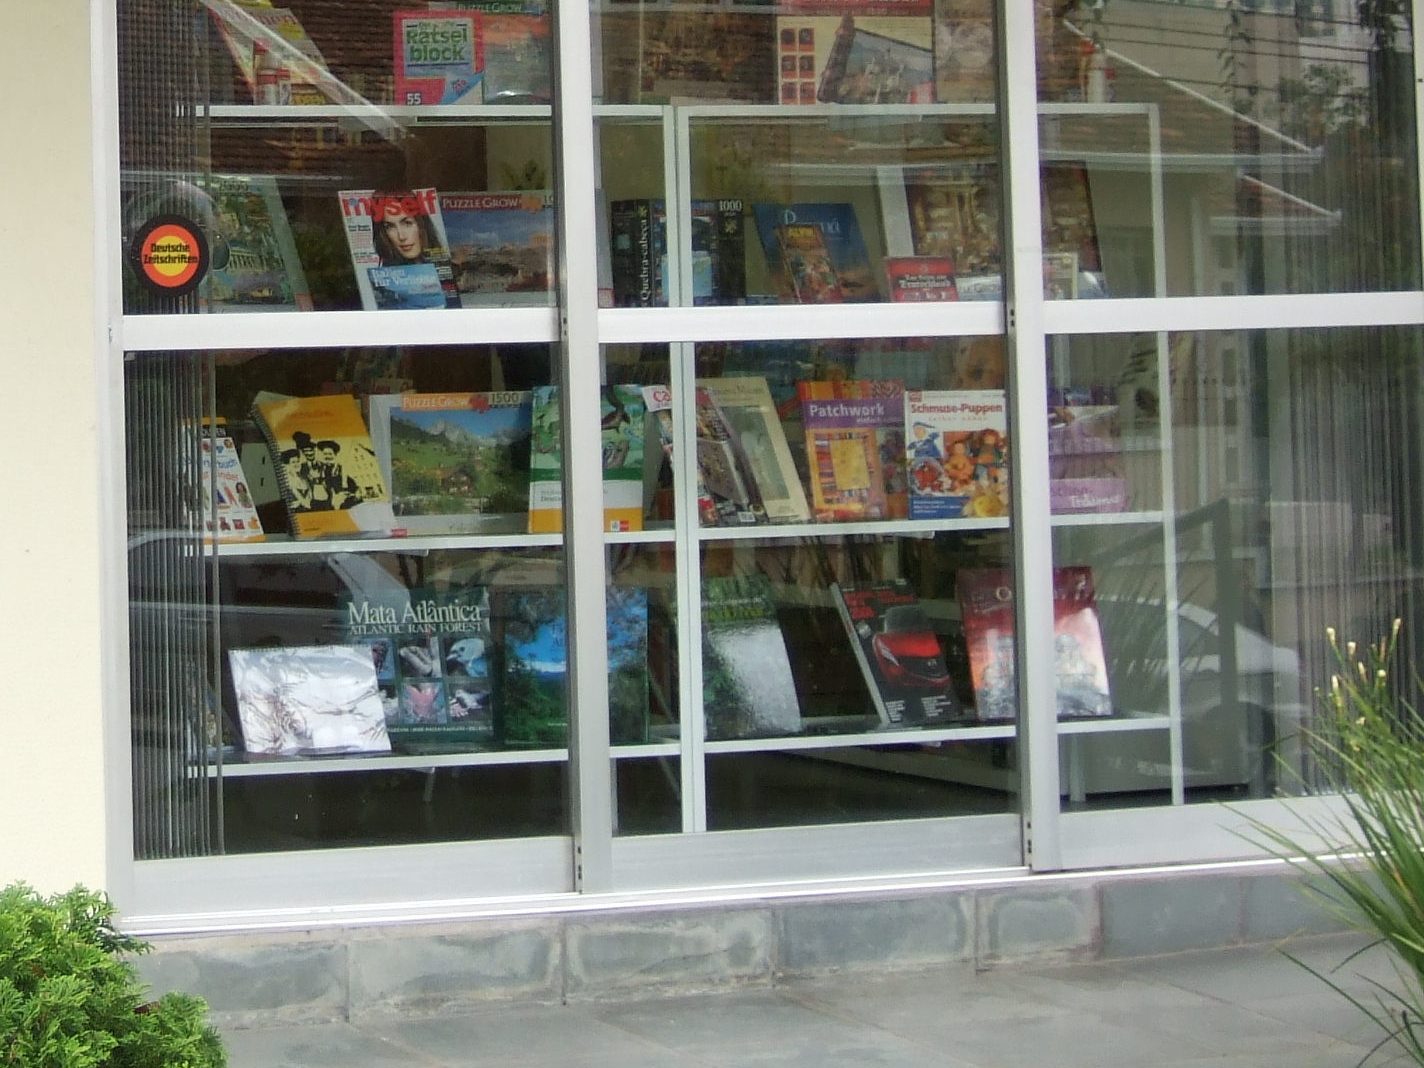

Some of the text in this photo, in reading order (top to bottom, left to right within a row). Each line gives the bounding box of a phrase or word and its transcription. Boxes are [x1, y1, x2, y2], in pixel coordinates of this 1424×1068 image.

[409, 44, 466, 62] block
[406, 92, 422, 105] 55
[341, 190, 438, 222] myself
[718, 200, 743, 212] 1000
[150, 243, 191, 254] Deutsche
[143, 253, 199, 265] Zeitschriften
[491, 392, 521, 405] 1500
[809, 400, 886, 417] Patchwork
[910, 403, 1003, 416] Schmuse-Puppen
[347, 599, 482, 625] Mata Atlântica
[349, 621, 483, 635] ATLANTIC RAIN FOREST
